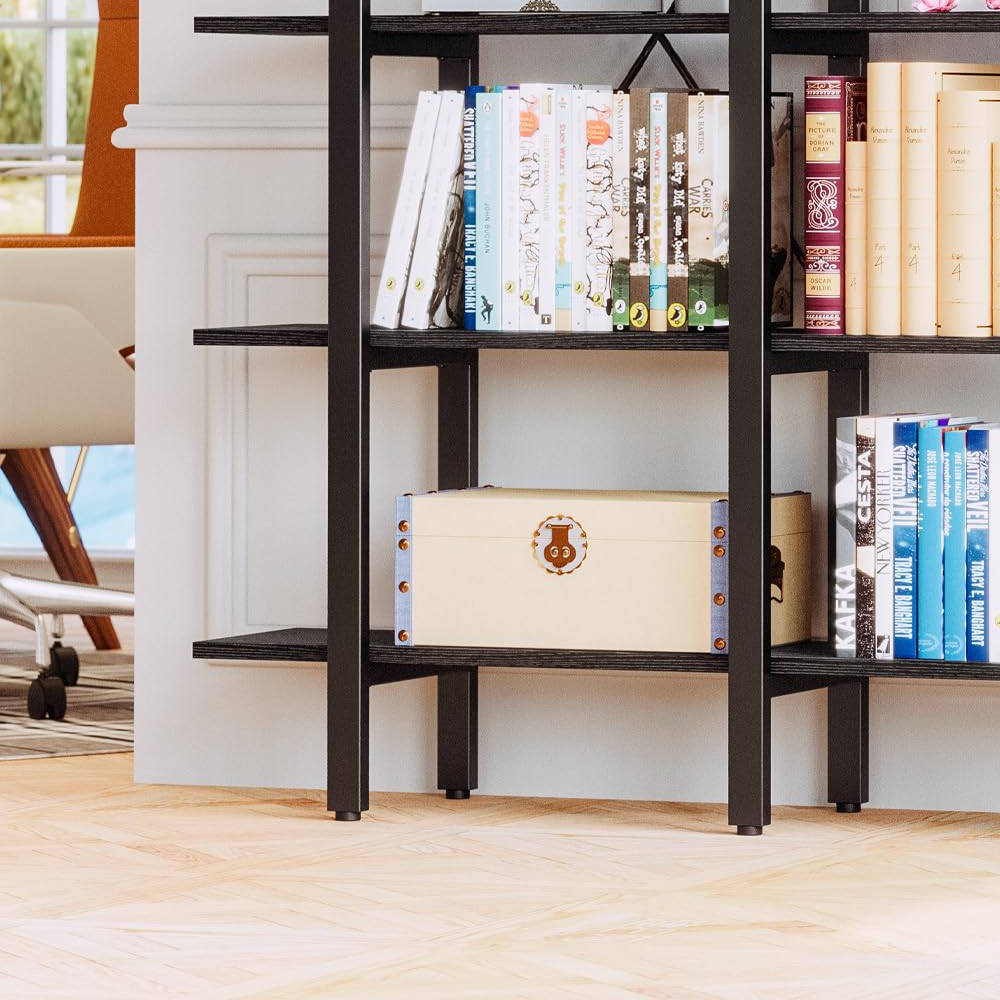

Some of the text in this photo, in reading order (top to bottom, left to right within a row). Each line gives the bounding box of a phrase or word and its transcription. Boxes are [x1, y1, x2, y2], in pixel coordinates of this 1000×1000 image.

[688, 186, 701, 214] WAR
[701, 178, 713, 219] CARRIES
[857, 448, 872, 524] CESTA
[893, 445, 906, 497] SHATTERED
[966, 450, 989, 531] SHATTERED VEIL
[877, 469, 892, 574] NEW YORKER
[894, 556, 913, 583] TRACY
[970, 560, 985, 588] TRACY
[836, 564, 857, 650] KAFKA
[894, 594, 913, 639] BANGHART
[970, 600, 985, 647] BANGHART
